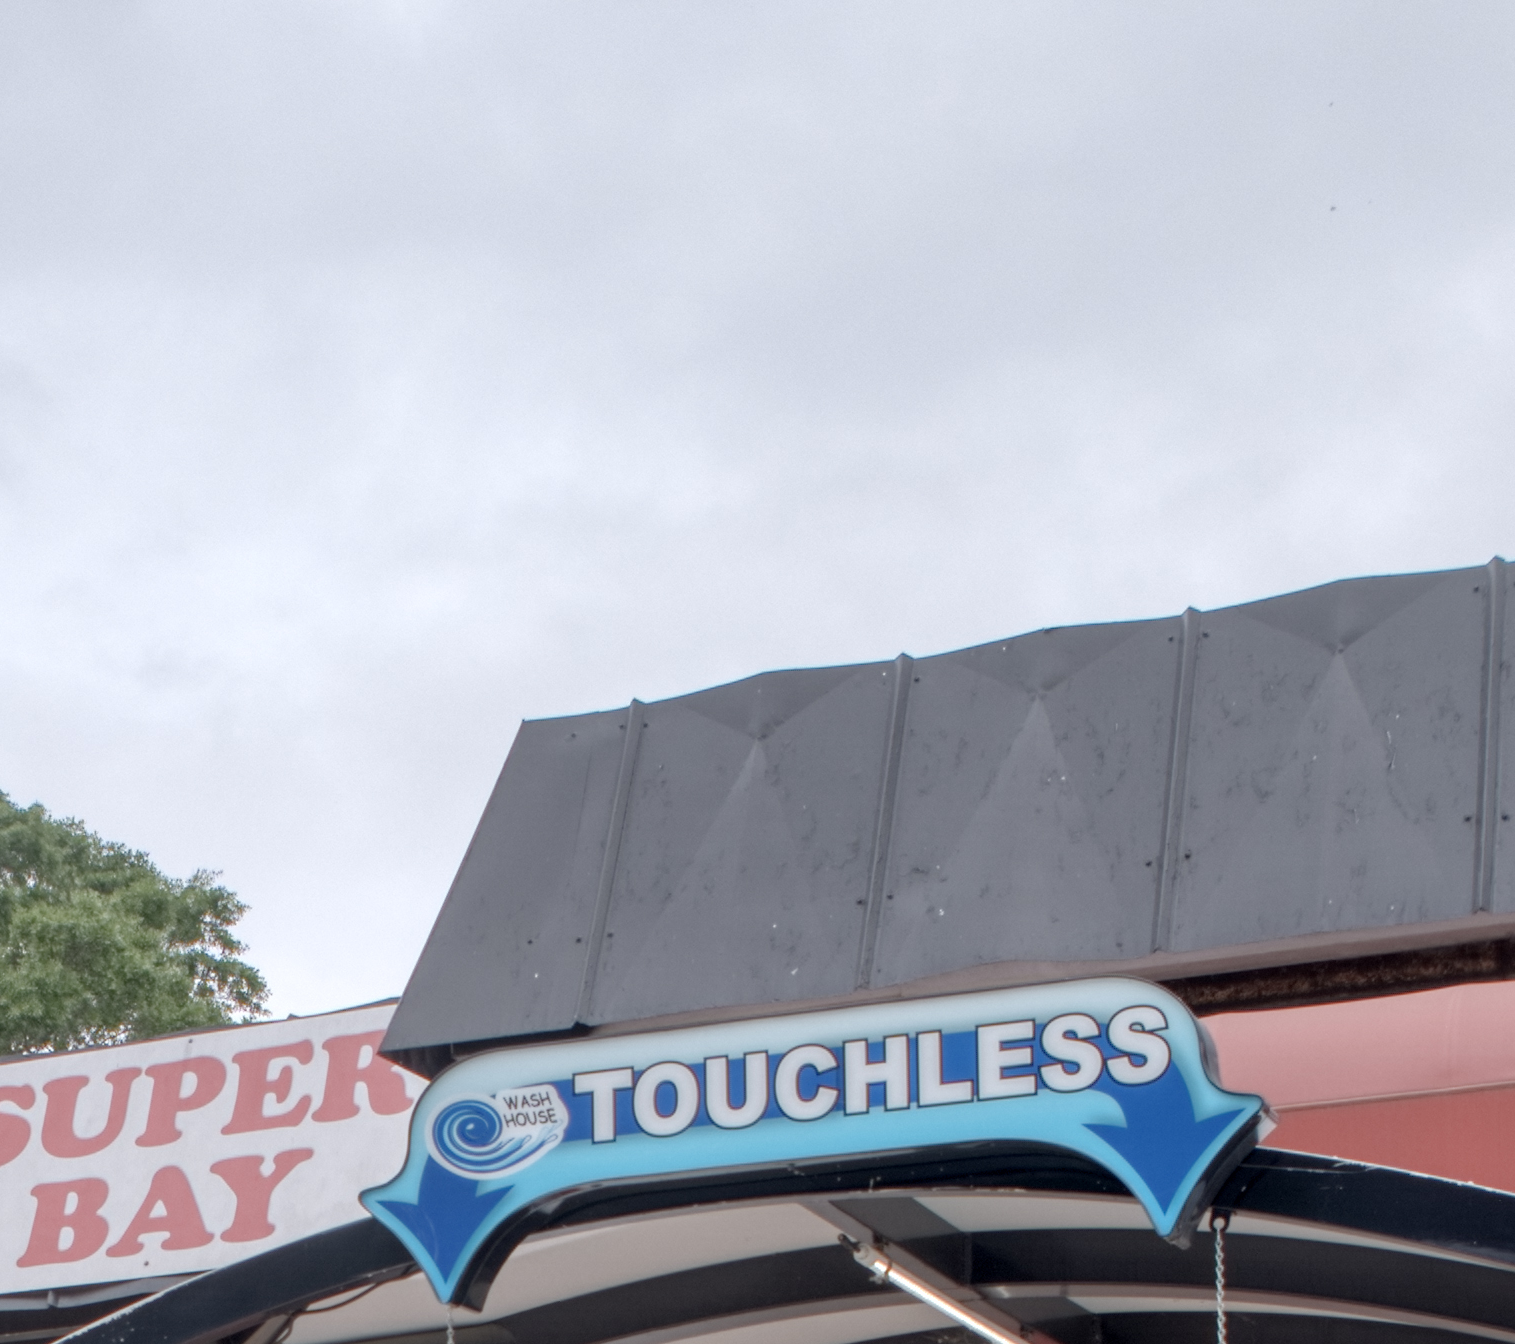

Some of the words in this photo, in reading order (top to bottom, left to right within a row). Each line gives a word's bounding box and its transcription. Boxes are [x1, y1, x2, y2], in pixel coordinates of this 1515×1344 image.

[503, 1091, 552, 1110] WASH
[573, 1004, 1169, 1144] TOUCHLESS
[503, 1108, 558, 1128] HOUSE
[16, 1148, 313, 1268] BAY
